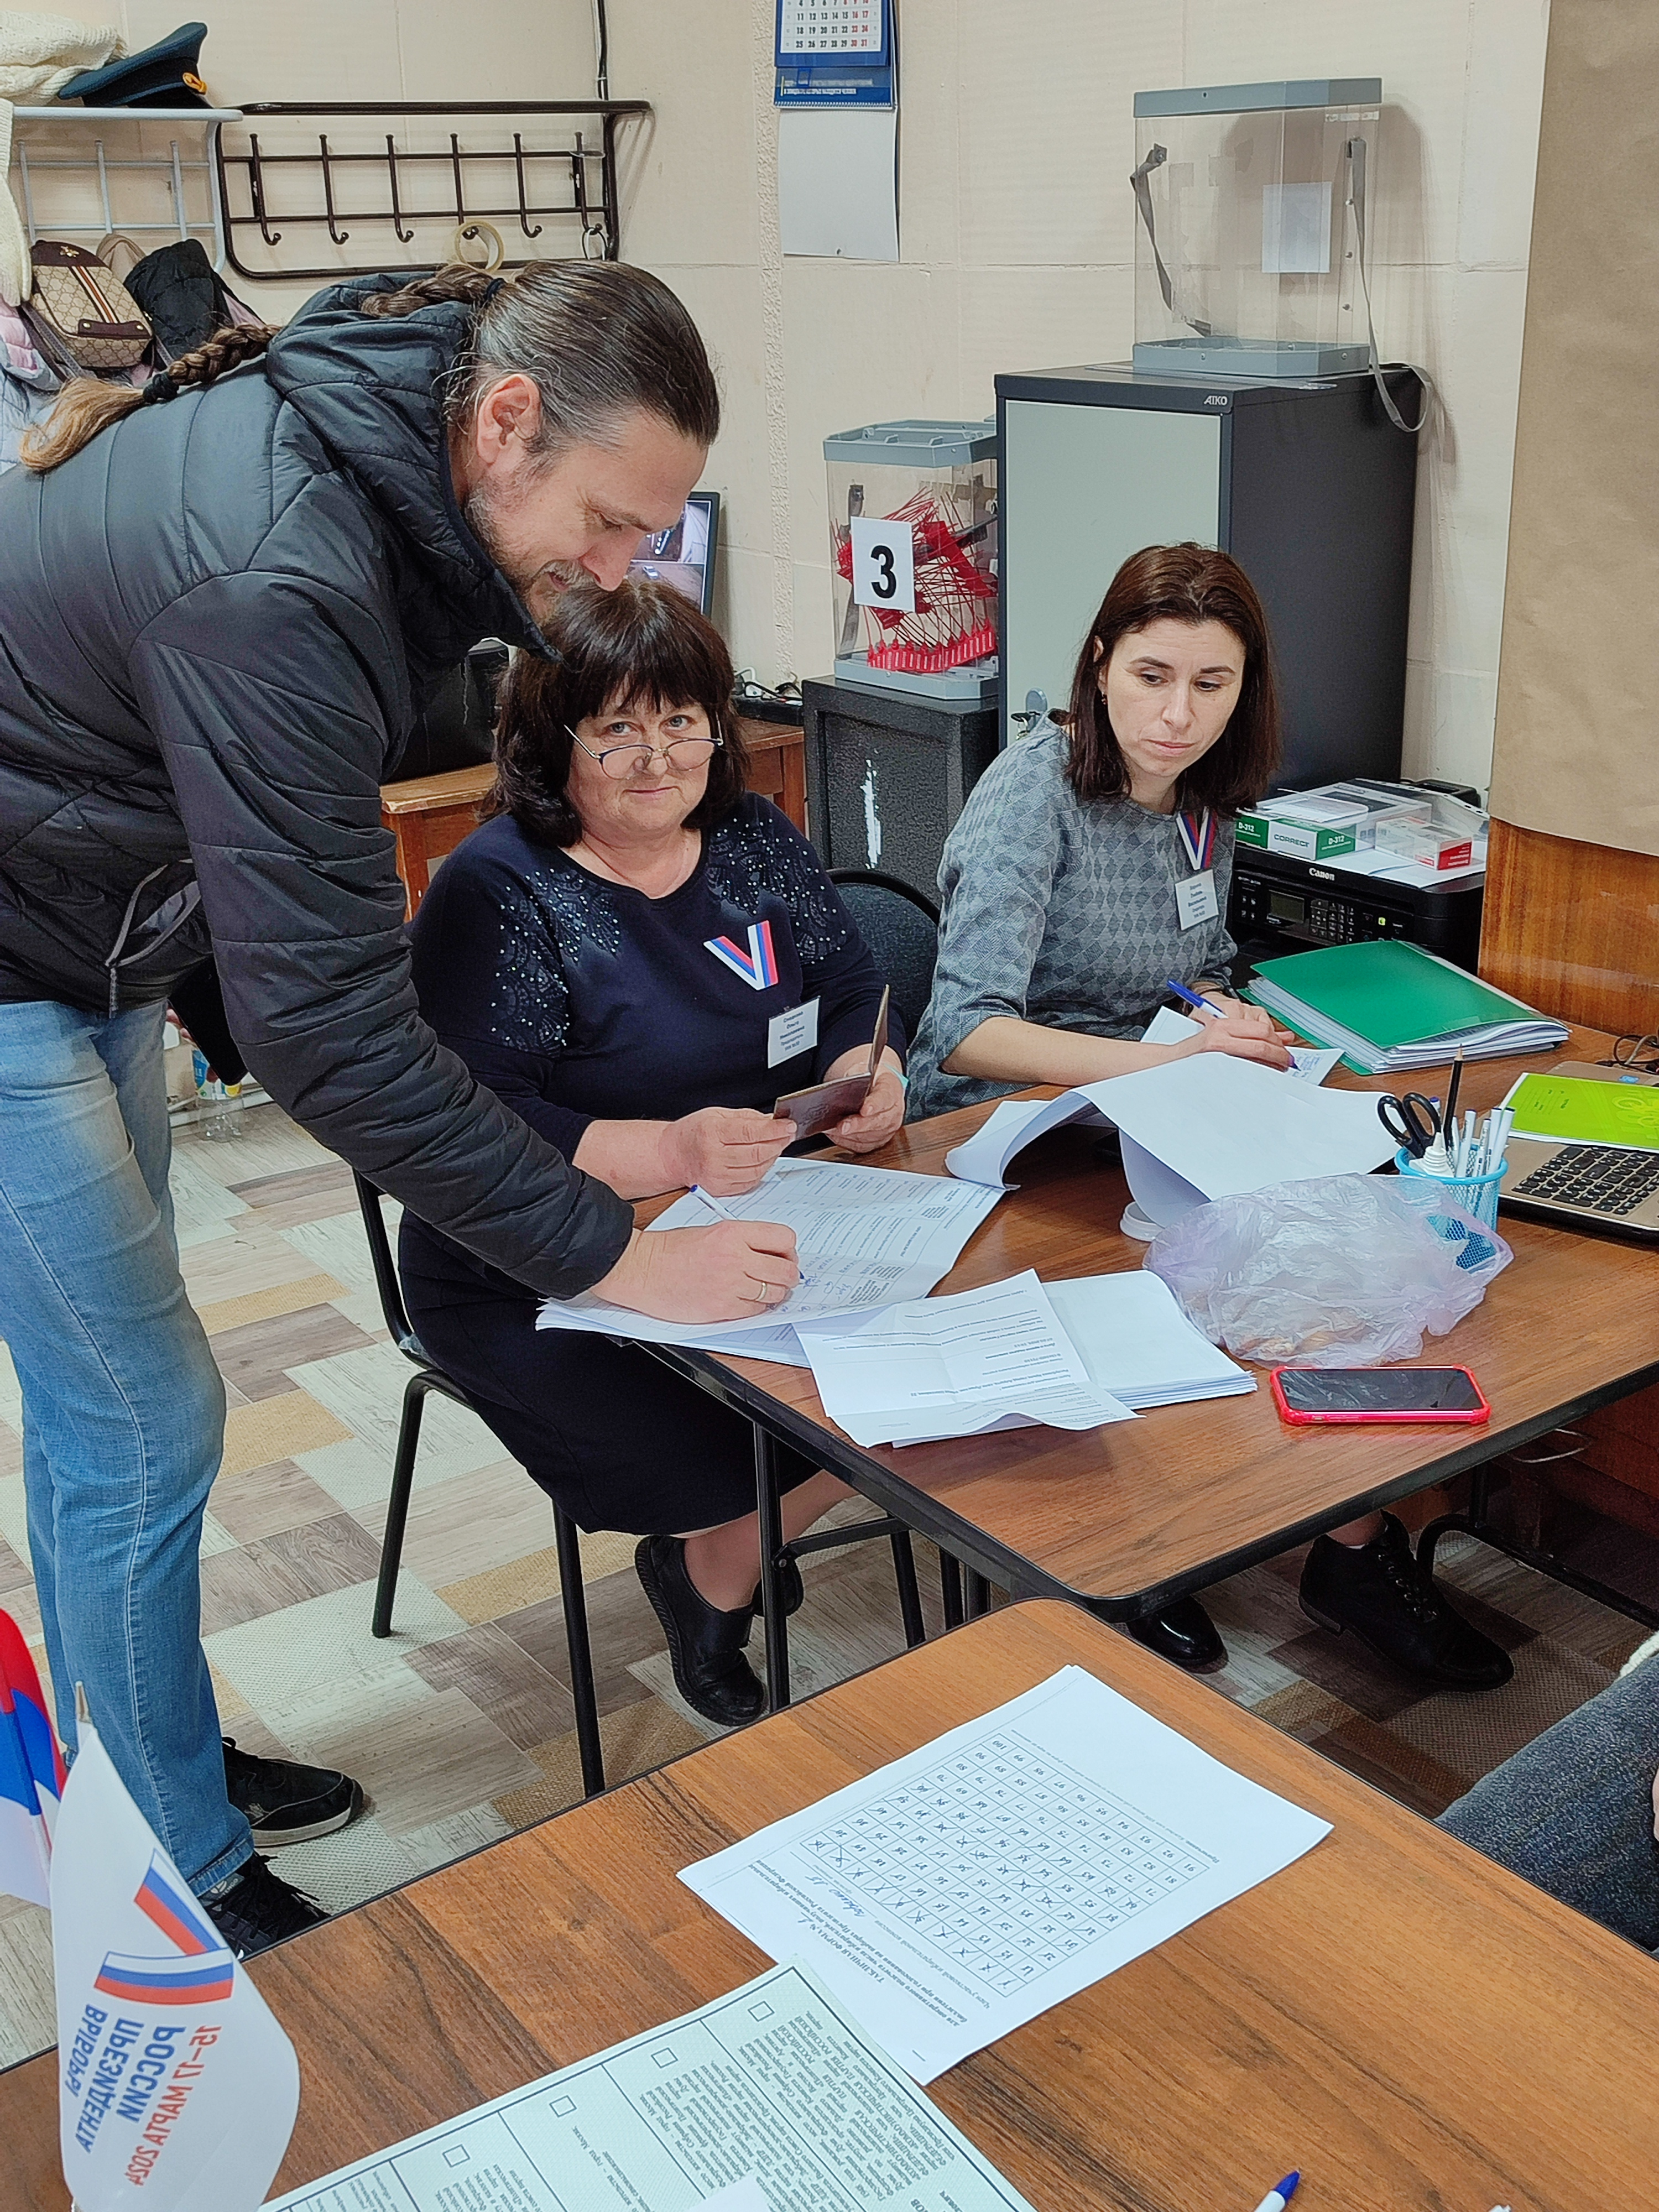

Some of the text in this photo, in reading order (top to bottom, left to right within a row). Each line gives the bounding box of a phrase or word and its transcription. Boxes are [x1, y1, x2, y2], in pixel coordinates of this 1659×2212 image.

[841, 39, 847, 48] 29
[1203, 395, 1228, 405] AIKO
[870, 545, 897, 599] 3
[1238, 822, 1255, 832] D-312
[1274, 834, 1310, 848] CORRECT
[1328, 835, 1345, 845] D-312
[1309, 868, 1335, 881] Canon
[992, 1740, 1006, 1750] 100
[1037, 1816, 1047, 1824] 76
[1117, 1821, 1129, 1829] 94
[1057, 1830, 1069, 1838] 75
[1098, 1832, 1111, 1840] 84
[1078, 1844, 1091, 1853] 74
[1120, 1847, 1133, 1855] 83
[1162, 1849, 1174, 1858] 92
[1100, 1859, 1113, 1868] 73
[1142, 1861, 1156, 1870] 82
[1183, 1863, 1195, 1871] 91
[1123, 1874, 1135, 1882] 72
[1165, 1875, 1177, 1884] 81
[1145, 1888, 1156, 1896] 71
[817, 1929, 842, 1949] ФОРМА
[920, 1986, 934, 1997] при
[905, 1985, 947, 2017] оперативного
